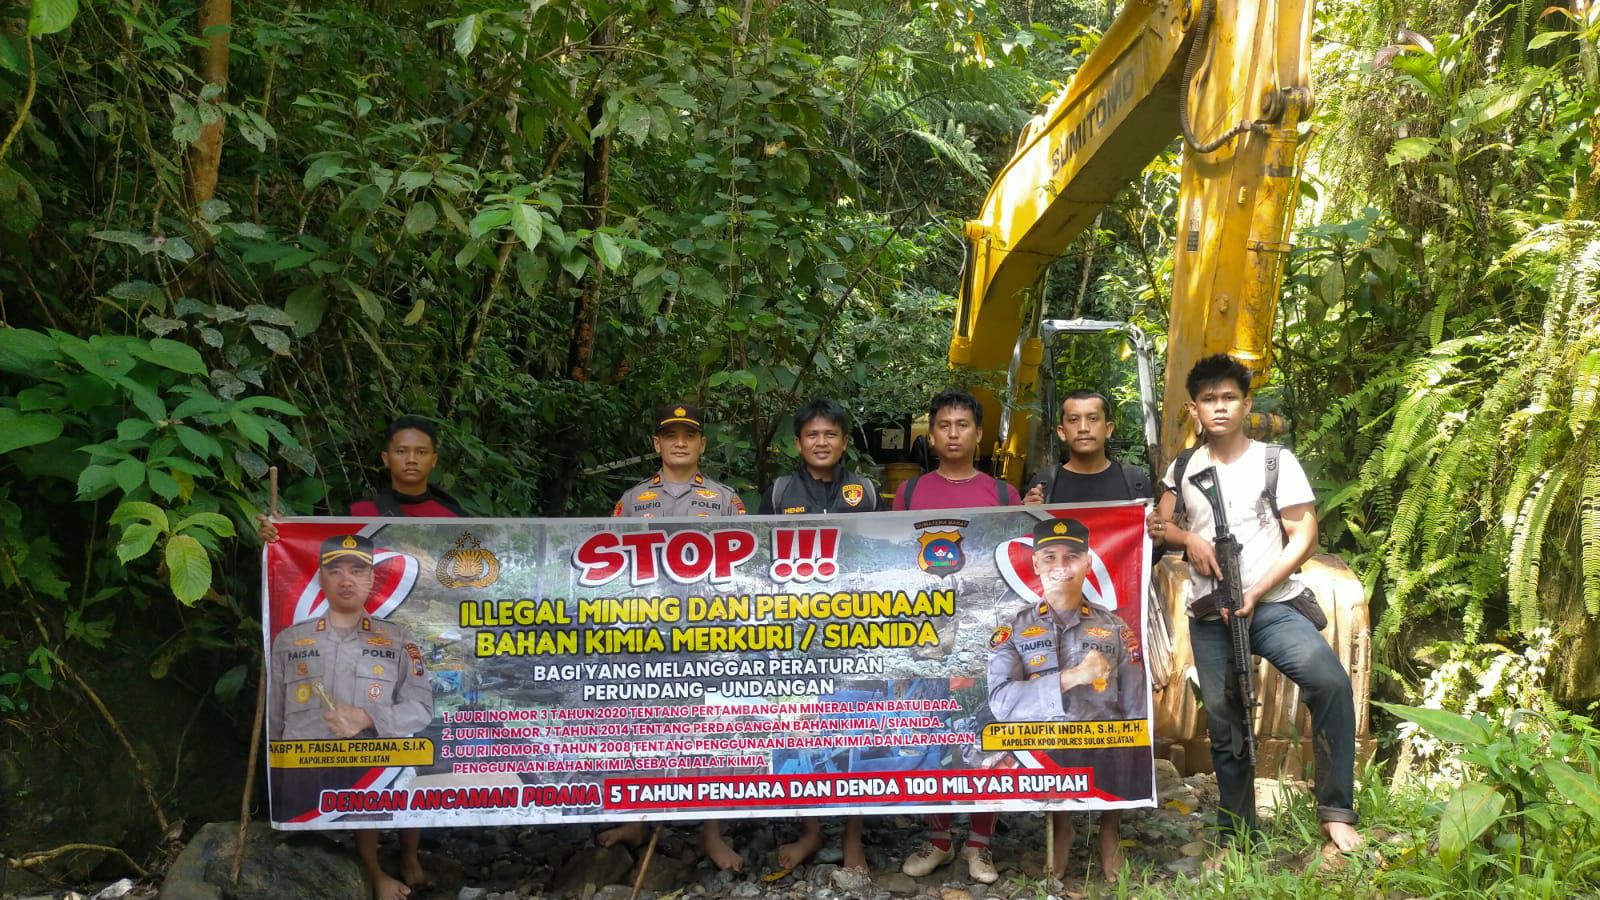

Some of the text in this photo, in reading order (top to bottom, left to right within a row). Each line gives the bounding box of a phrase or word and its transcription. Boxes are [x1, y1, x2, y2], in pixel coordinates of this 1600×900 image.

[1051, 67, 1135, 176] SUMITOMO
[634, 501, 661, 512] TAUFIQ
[691, 500, 721, 510] POLRI
[573, 530, 757, 586] STOP
[460, 590, 955, 627] ILLEGAL MINING DAN PENGGUNAAN
[476, 621, 940, 658] BAHAN KIMIA MERKURI / SIANIDA
[1019, 639, 1052, 653] TAUFIQ
[288, 649, 320, 661] FAISAL
[362, 649, 395, 660] POLRI
[534, 656, 883, 682] BAGI YANG MELANGGAR PERATURAN
[583, 682, 703, 701] PERUNDANG
[721, 679, 834, 698] UNDANGAN
[443, 699, 962, 724] 1. UU RI NOMOR 3 TAHUN 2020 TENTANG PERTAMBANGAN MINERAL DAN BATU BARA.
[442, 728, 454, 741] 2.
[456, 728, 474, 740] UU
[476, 727, 489, 739] RI
[491, 727, 540, 739] NOMOR
[545, 726, 552, 737] 7
[554, 725, 600, 738] TAHUN
[601, 724, 630, 736] 2014
[632, 722, 691, 736] TENTANG
[693, 720, 791, 734] PERDAGANGAN
[793, 719, 839, 732] BAHAN
[840, 718, 878, 731] KIMIA
[888, 716, 945, 729] SIANIDA.
[990, 725, 1015, 736] IPTU
[1018, 724, 1056, 736] TAUFIK
[1058, 723, 1095, 735] INDRA,
[1122, 722, 1143, 733] M.H.
[295, 743, 306, 753] M.
[308, 742, 345, 753] FAISAL
[348, 741, 401, 753] PERDANA,
[402, 740, 426, 751] S.I.K
[441, 732, 976, 758] 3. UU RI NOMOR 9 TAHUN 2008 TENTANG PENGGUNAAN BAHAN KIMIA DAN LARANGAN
[1057, 738, 1083, 746] POLRES
[1084, 737, 1106, 745] SOLOK
[1107, 736, 1134, 744] SELATAN
[300, 754, 390, 765] KAPOLRES SOLOK SELATAN
[453, 755, 769, 774] PENGGUNAAN BAHAN KIMIA SEBAGAI ALAT KIMIA.
[320, 774, 1088, 813] DENGAN ANCAMAN PIDANA 5 TAHUN PENJARA DAN DENDA 100 MILYAR RUPIAH
